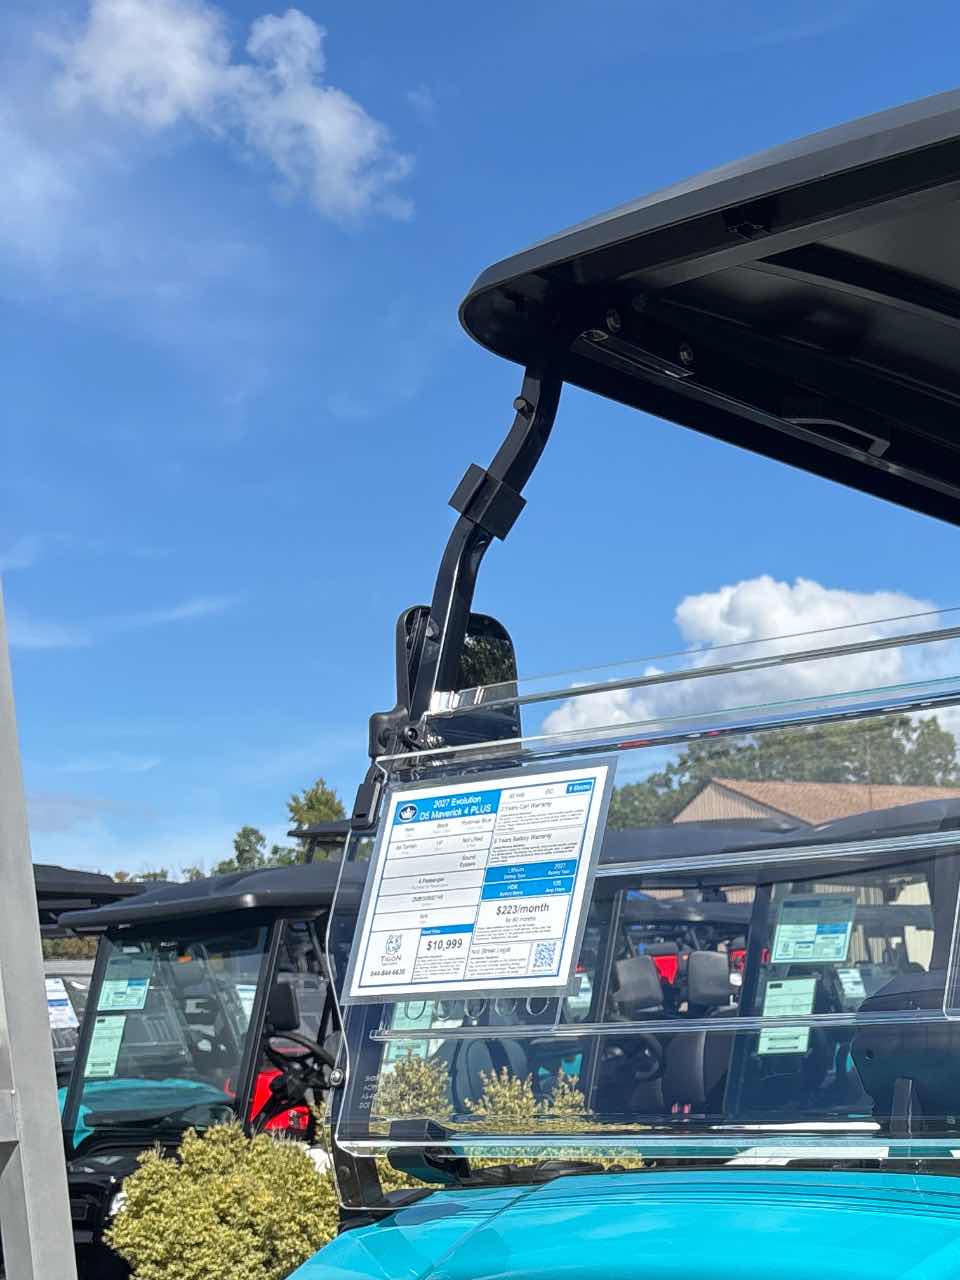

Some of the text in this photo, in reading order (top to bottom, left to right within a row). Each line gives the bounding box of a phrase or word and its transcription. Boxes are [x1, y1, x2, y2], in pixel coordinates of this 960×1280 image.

[432, 796, 482, 808] 2027 Evolution
[431, 808, 462, 820] Maverick
[464, 806, 469, 814] 4
[471, 804, 492, 814] PLUS
[496, 904, 550, 916] $223/month
[426, 938, 462, 951] $10,999
